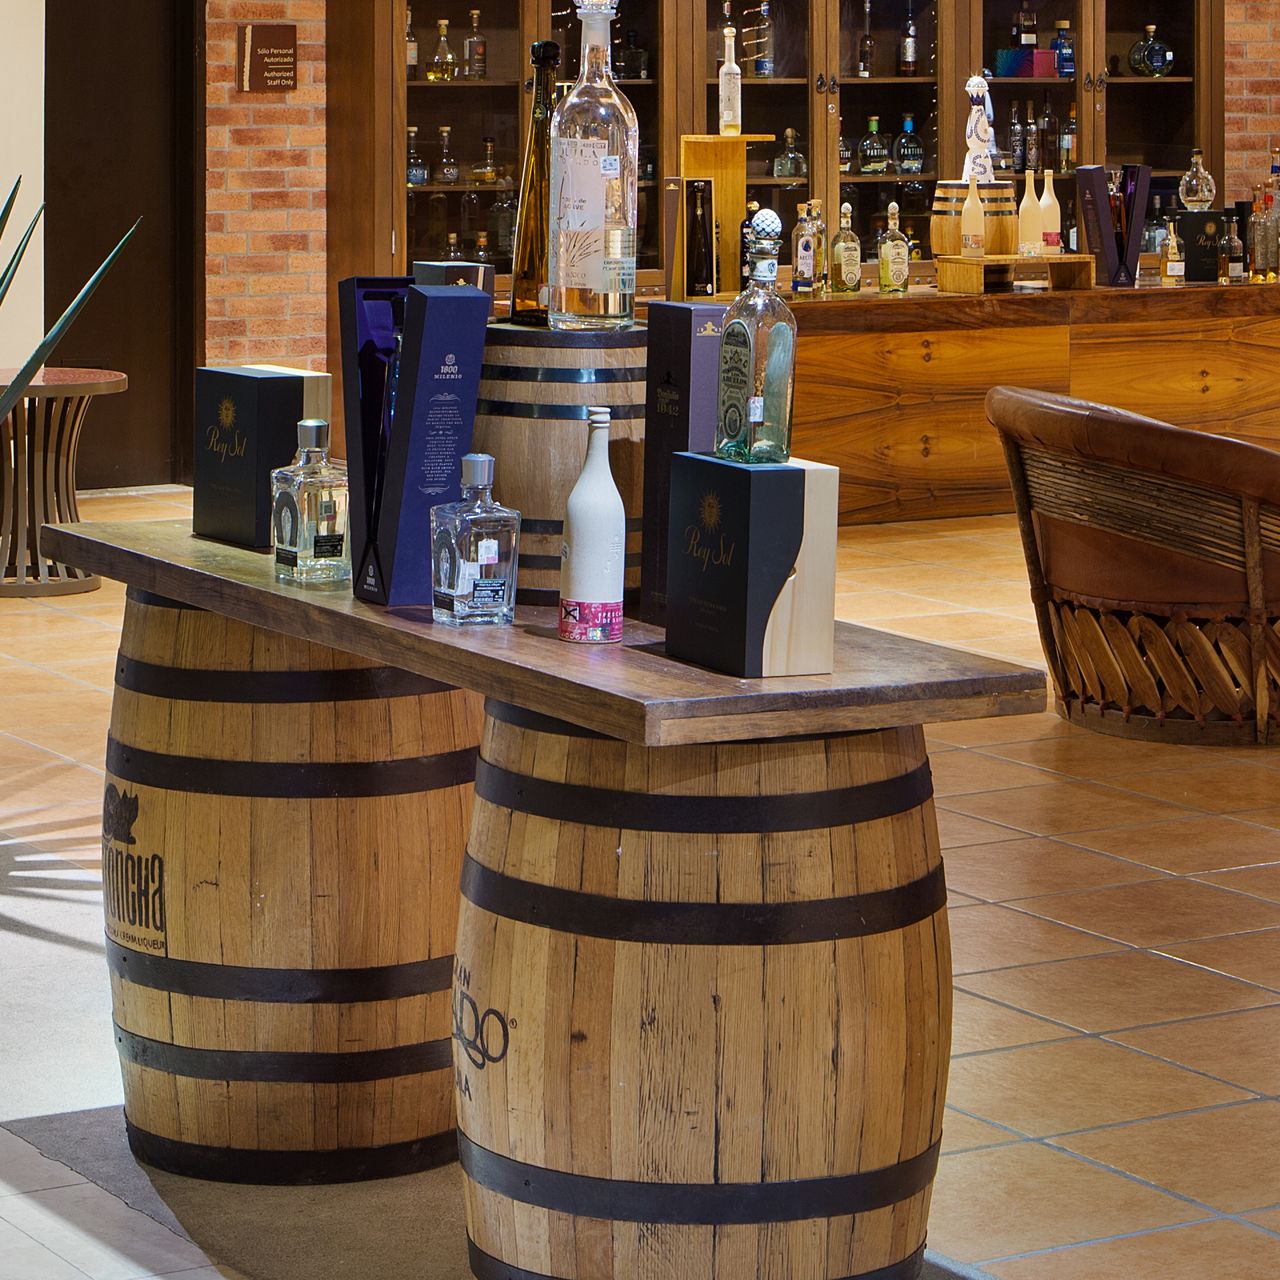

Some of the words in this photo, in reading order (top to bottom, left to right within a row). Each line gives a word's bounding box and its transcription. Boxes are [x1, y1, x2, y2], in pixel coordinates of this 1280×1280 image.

[270, 47, 294, 55] Personal
[281, 79, 294, 87] Only
[440, 365, 458, 373] 1800
[206, 425, 228, 463] Rey
[229, 429, 247, 457] Sol
[682, 525, 711, 572] Rey
[711, 532, 736, 566] Sol
